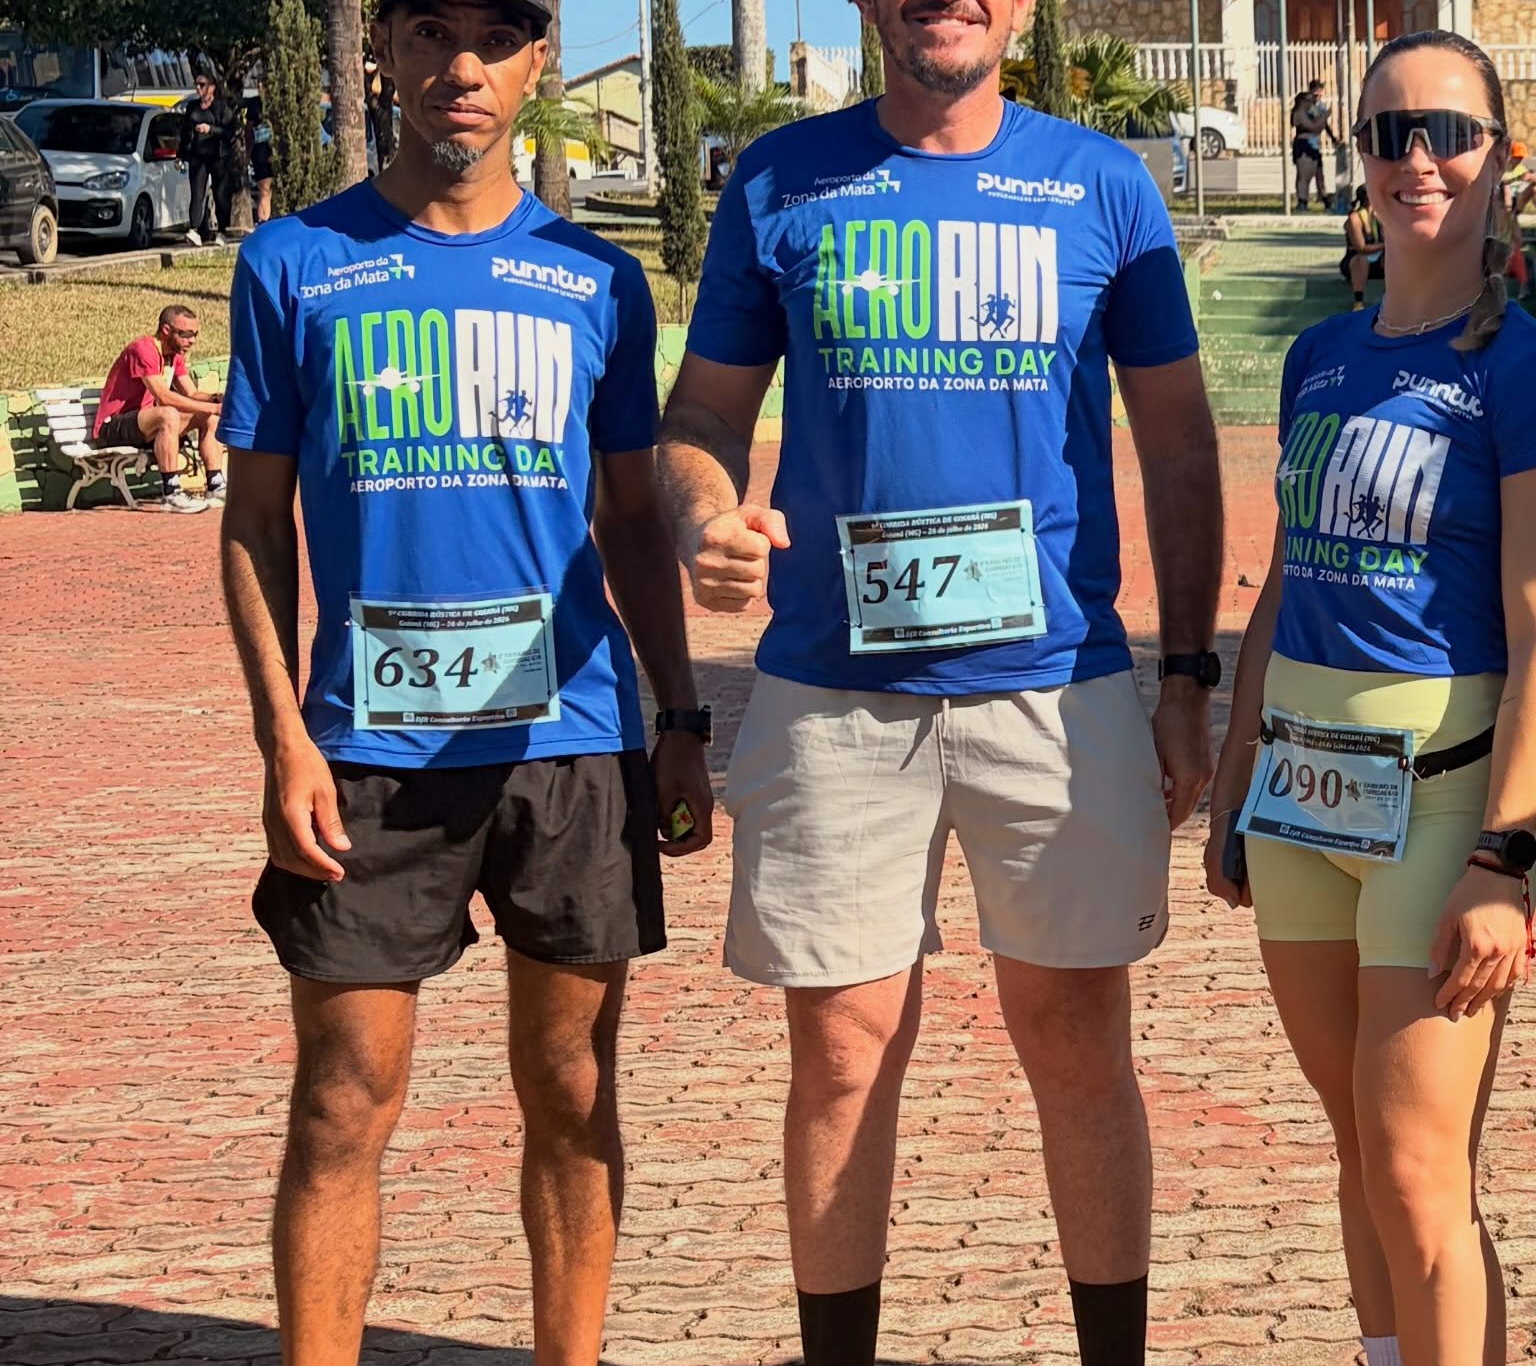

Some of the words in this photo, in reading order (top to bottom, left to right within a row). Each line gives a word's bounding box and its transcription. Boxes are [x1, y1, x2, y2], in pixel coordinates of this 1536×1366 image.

[815, 174, 861, 187] Aeroporto
[863, 171, 875, 181] da
[782, 192, 817, 208] Zona
[820, 186, 837, 200] da
[840, 184, 875, 196] Mata
[328, 260, 375, 278] Aeroporto
[376, 256, 388, 267] da
[334, 277, 352, 291] da
[354, 270, 390, 287] Mata
[813, 219, 931, 340] AERO
[938, 220, 1058, 344] RUN
[335, 308, 453, 444] AERO
[454, 309, 573, 444] RUN
[818, 347, 984, 375] TRAINING
[995, 348, 1057, 376] DAY
[829, 376, 913, 390] AEROPORTO
[919, 377, 940, 390] DA
[943, 377, 986, 391] ZONA
[989, 377, 1009, 391] DA
[1013, 377, 1049, 392] MATA
[340, 443, 505, 477] TRAINING
[350, 474, 438, 494] AEROPORTO
[441, 475, 463, 488] DA
[467, 473, 509, 487] ZONA
[1319, 415, 1452, 545] RUN
[1359, 546, 1429, 576] DAY
[862, 554, 963, 605] 547
[1301, 565, 1313, 579] DA
[1317, 569, 1348, 584] ZONA
[1351, 573, 1369, 586] DA
[1373, 575, 1416, 590] MATA
[373, 646, 478, 689] 634
[1268, 757, 1343, 809] 090
